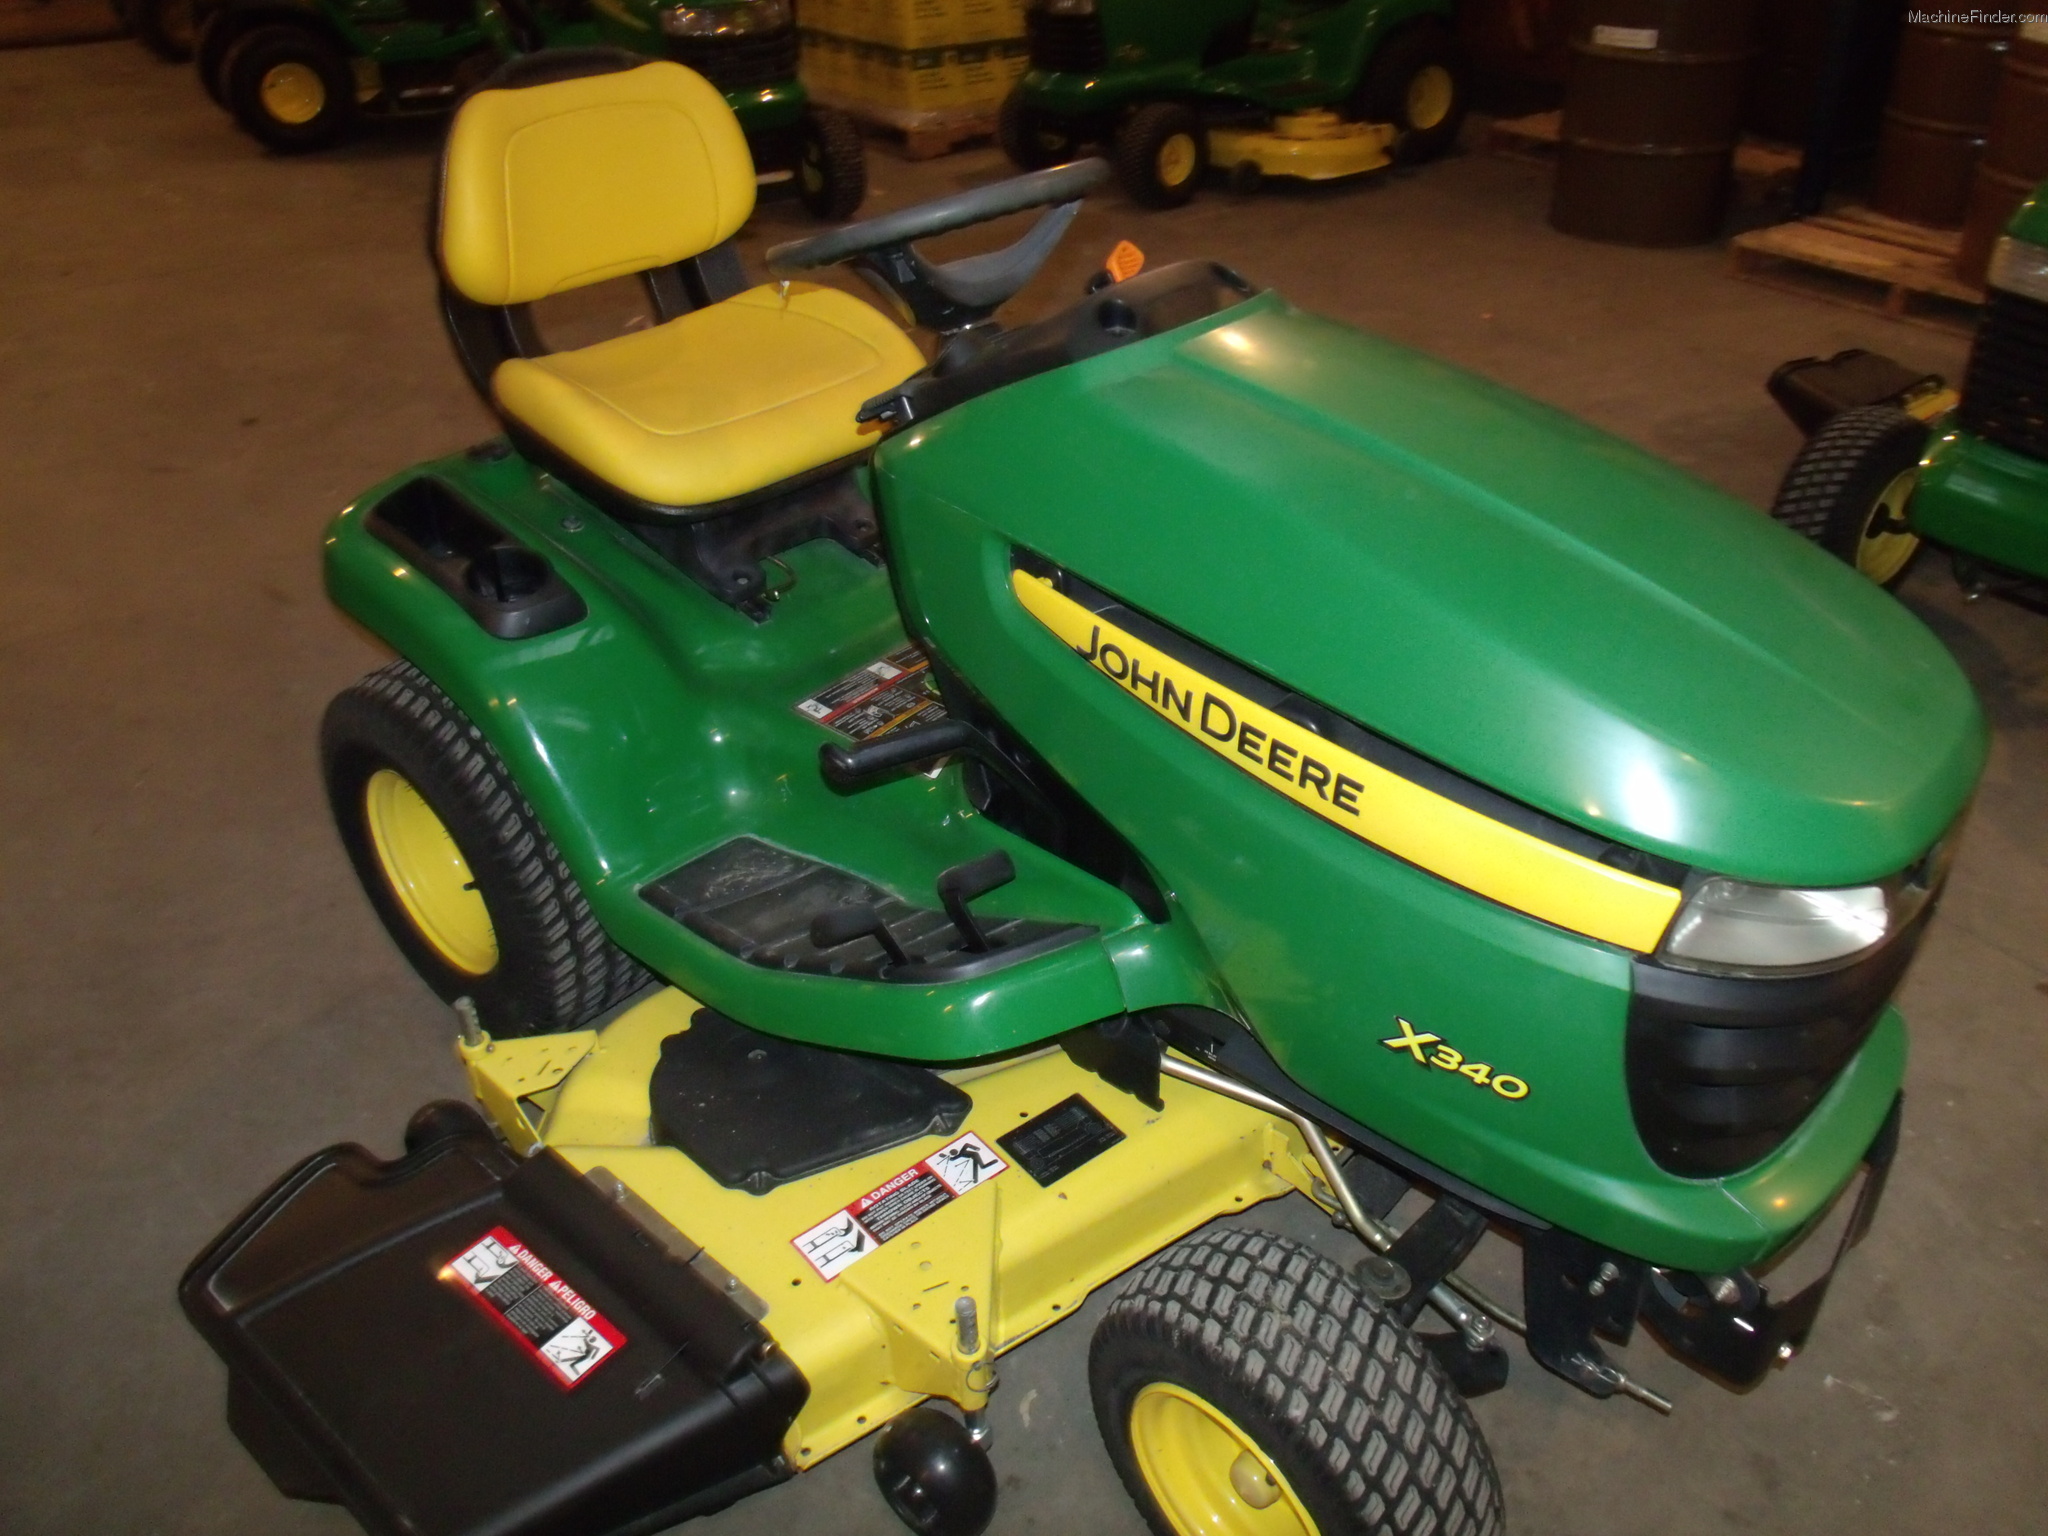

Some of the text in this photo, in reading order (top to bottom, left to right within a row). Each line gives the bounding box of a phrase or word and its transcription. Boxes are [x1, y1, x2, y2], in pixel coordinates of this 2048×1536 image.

[1076, 624, 1365, 816] JOHN DEERE
[1380, 1016, 1530, 1100] X340
[869, 1167, 918, 1200] DANGER
[517, 1248, 553, 1281] DANGER
[557, 1284, 597, 1320] PELIGRO
